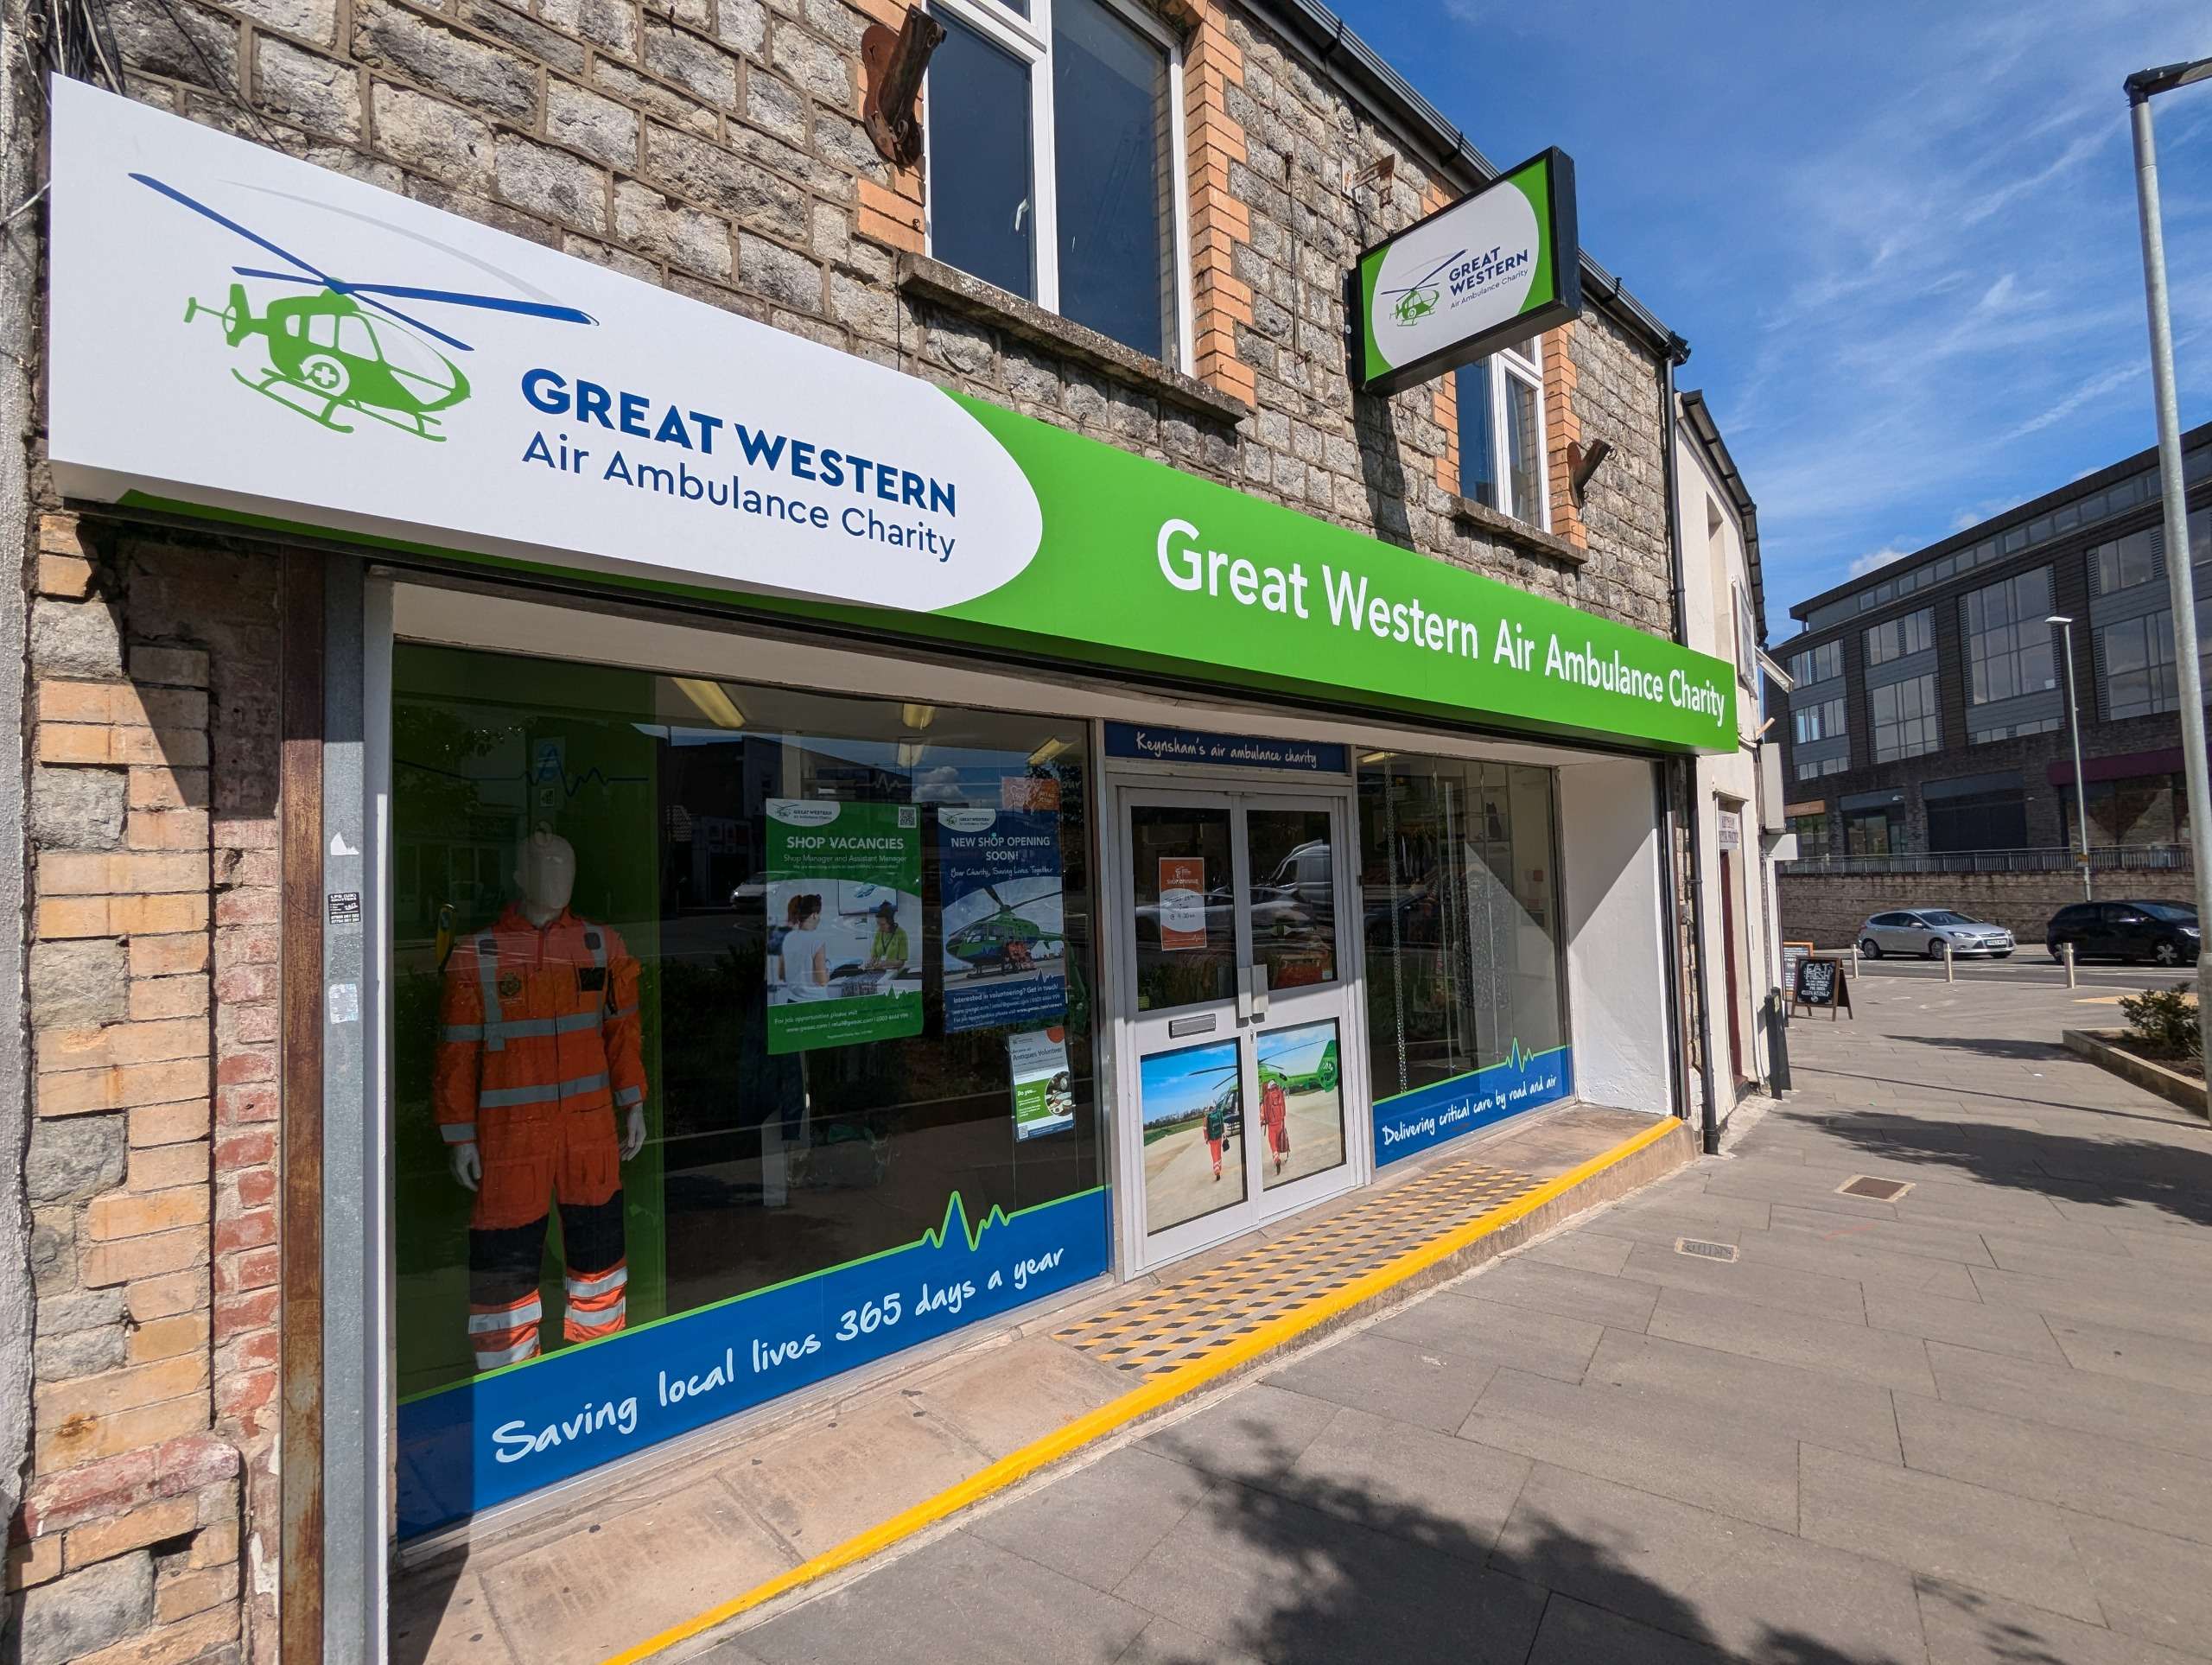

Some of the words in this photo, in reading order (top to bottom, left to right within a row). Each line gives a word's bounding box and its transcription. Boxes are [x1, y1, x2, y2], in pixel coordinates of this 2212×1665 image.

[1448, 246, 1501, 282] GREAT
[1450, 249, 1529, 296] WESTERN
[1450, 299, 1460, 309] Air
[1461, 282, 1500, 304] Ambulance
[1501, 269, 1529, 286] Charity
[521, 368, 723, 454] GREAT
[734, 423, 956, 518] WESTERN
[521, 430, 589, 474] Air
[603, 450, 830, 528] Ambulance
[842, 507, 956, 562] Charity
[1157, 518, 1309, 619] Great
[1322, 564, 1478, 659] Western
[1493, 619, 1535, 671] Air
[1544, 633, 1663, 702] Ambulance
[1669, 670, 1726, 728] Charity
[1135, 731, 1206, 758] Keynsham's
[1211, 743, 1226, 757] air
[1230, 744, 1281, 762] ambulance
[1285, 747, 1317, 768] charity
[784, 854, 802, 865] Shop
[803, 854, 833, 864] Manager
[835, 854, 848, 862] and
[849, 854, 877, 862] Assistant
[879, 854, 907, 865] Manager
[786, 836, 826, 849] SHOP
[830, 837, 904, 850] VACANCIES
[950, 837, 976, 848] NEW
[978, 836, 1004, 848] SHOP
[1007, 836, 1051, 847] OPENING
[986, 850, 1019, 861] SOON!
[1382, 1117, 1435, 1146] Delivering
[1439, 1099, 1470, 1126] critical
[1473, 1100, 1493, 1114] care
[1496, 1090, 1506, 1110] by
[1509, 1084, 1528, 1100] road
[1529, 1076, 1544, 1095] and
[1546, 1075, 1557, 1090] air
[492, 1397, 640, 1464] Saving
[658, 1347, 734, 1408] local
[752, 1334, 822, 1374] lives
[835, 1293, 901, 1343] 365
[914, 1281, 976, 1319] days
[988, 1272, 1003, 1291] a
[1014, 1248, 1065, 1289] year
